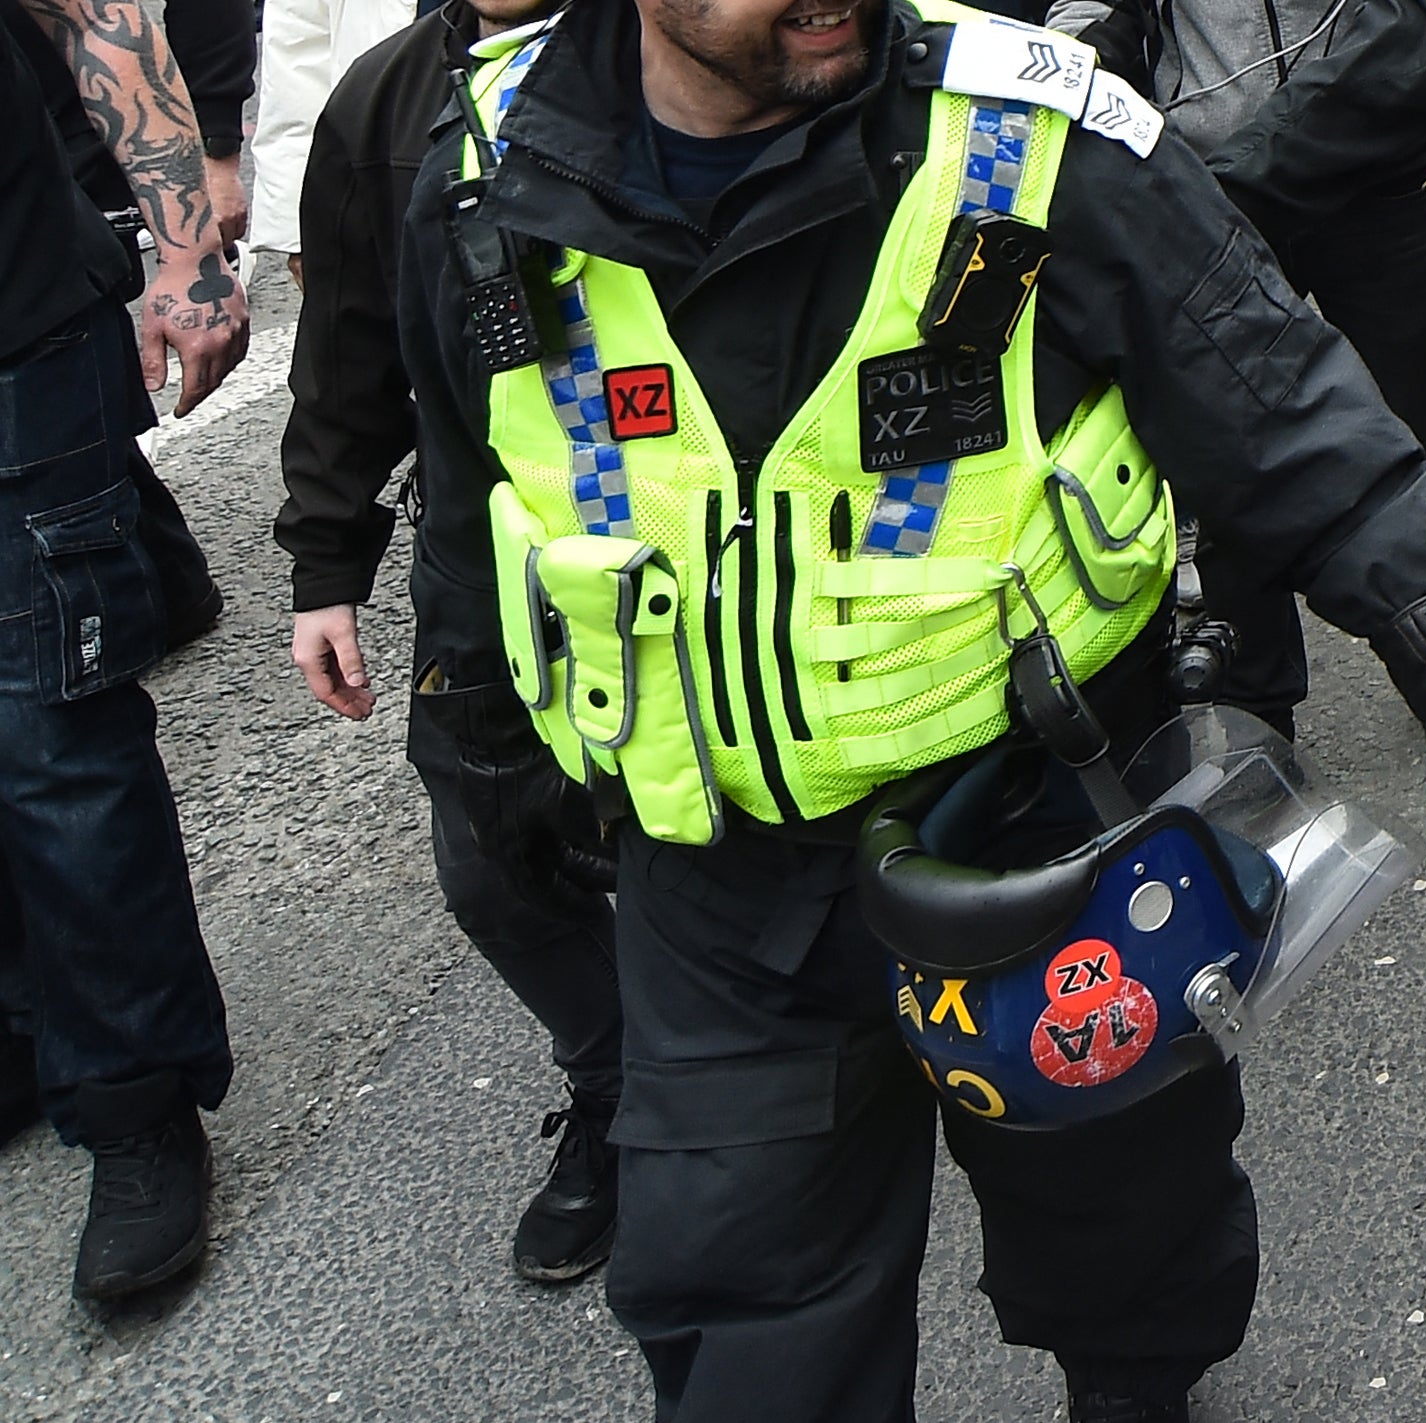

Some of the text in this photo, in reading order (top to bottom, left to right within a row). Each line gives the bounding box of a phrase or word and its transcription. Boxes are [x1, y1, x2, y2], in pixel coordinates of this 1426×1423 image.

[1063, 51, 1087, 91] 18241
[615, 382, 668, 421] XZ
[866, 359, 994, 405] POLICE
[873, 406, 930, 443] XZ
[868, 430, 1003, 467] TAU 18241
[1046, 1004, 1141, 1064] 1A
